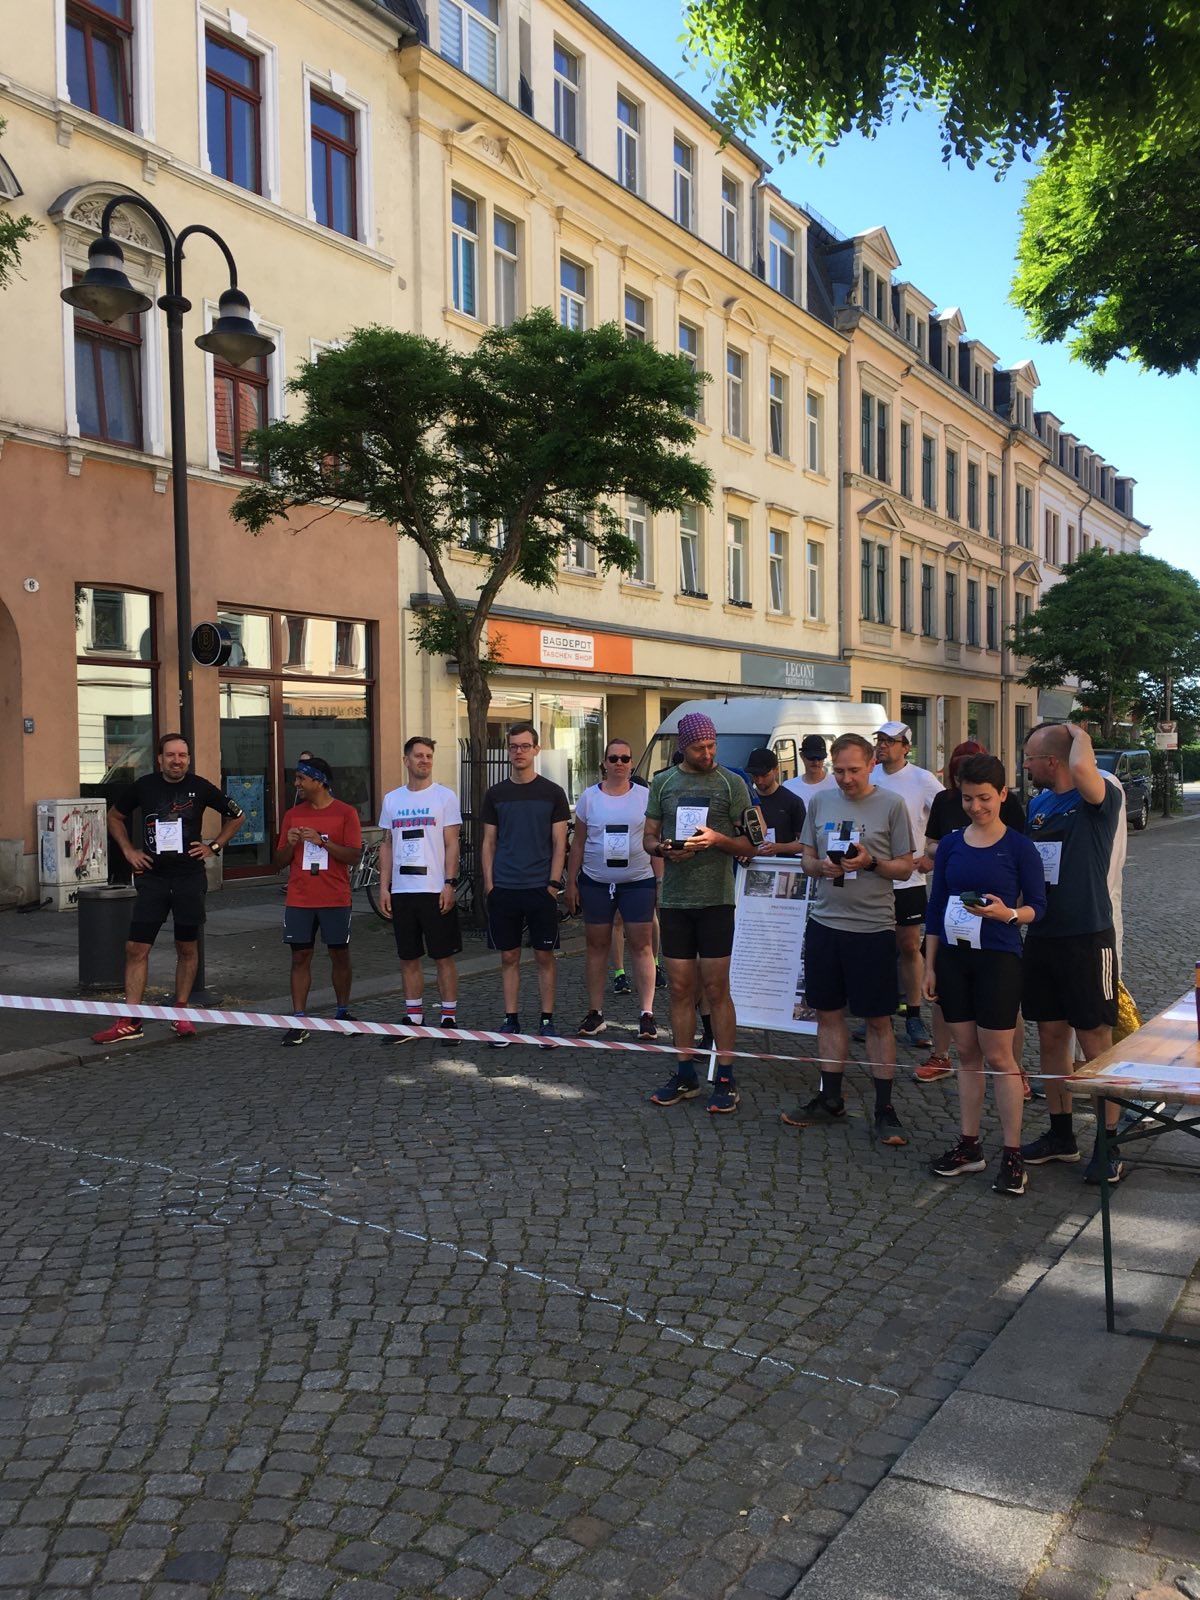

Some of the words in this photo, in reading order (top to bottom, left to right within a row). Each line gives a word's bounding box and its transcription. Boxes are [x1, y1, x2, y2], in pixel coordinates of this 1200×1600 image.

[543, 636, 592, 649] BAGDEPOT
[785, 661, 815, 679] LECONI
[396, 808, 430, 816] MIAMI
